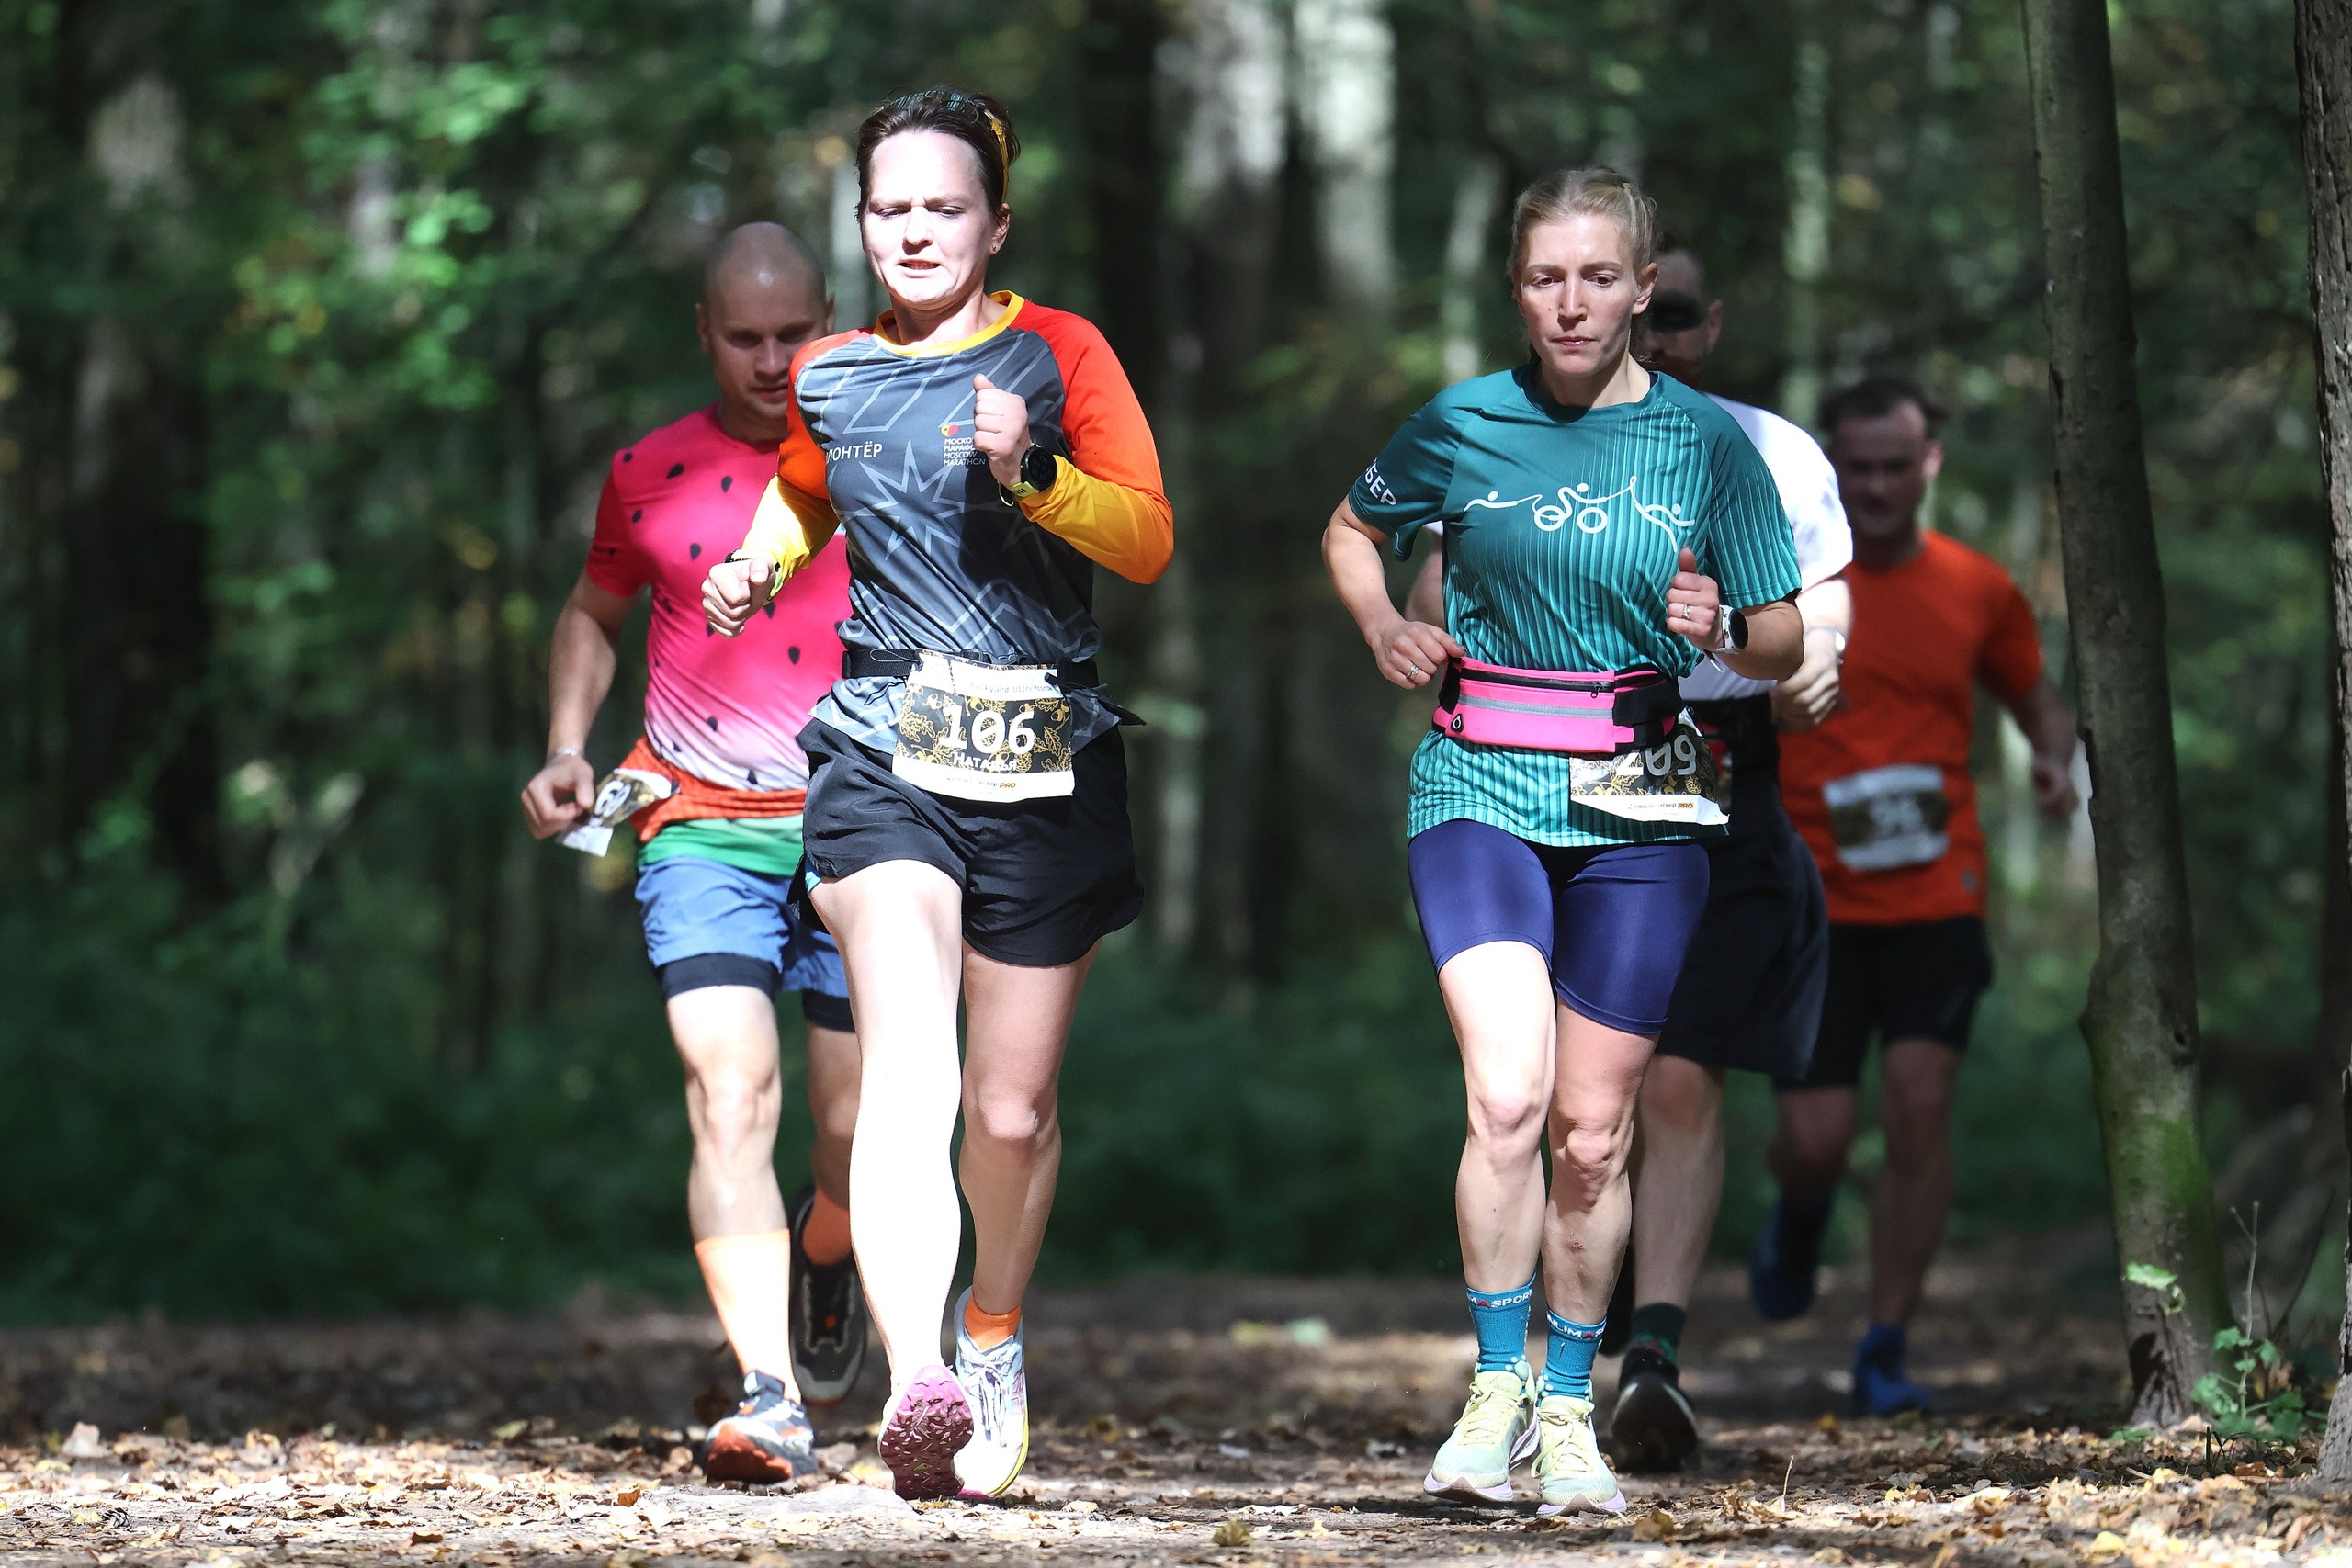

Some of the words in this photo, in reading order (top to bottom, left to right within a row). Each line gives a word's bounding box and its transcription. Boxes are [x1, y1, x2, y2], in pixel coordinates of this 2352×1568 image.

[826, 440, 883, 464] ЛОНТЁР
[944, 437, 974, 446] МОСКО
[944, 457, 986, 467] MARATHON
[1365, 457, 1397, 505] БЕР
[939, 705, 1035, 755] 106
